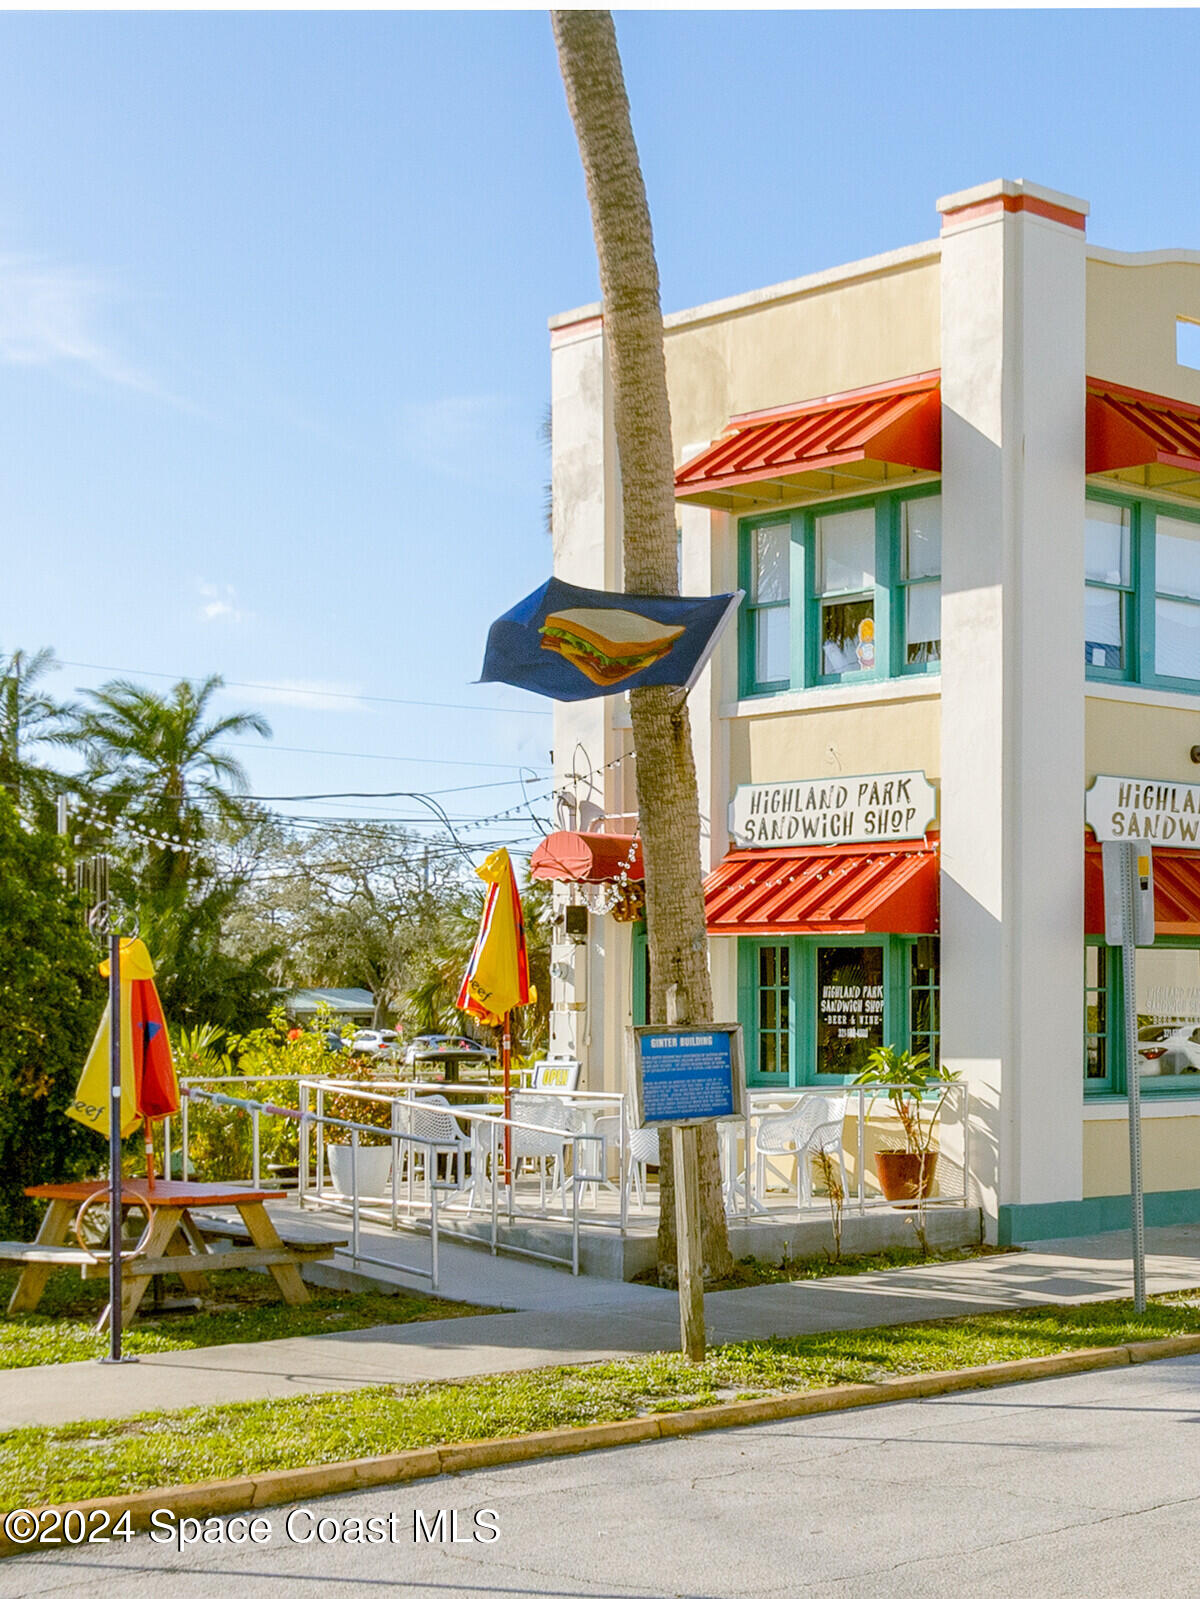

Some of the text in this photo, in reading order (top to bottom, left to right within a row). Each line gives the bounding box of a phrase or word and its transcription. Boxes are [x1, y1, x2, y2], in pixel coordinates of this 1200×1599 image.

[750, 778, 911, 815] HIGHLAND PARK
[744, 807, 916, 841] SANDWICH SHOP
[823, 985, 884, 999] HIGHLAND PARK
[821, 999, 885, 1013] SANDWICH SHOP
[651, 1036, 713, 1049] GINTER BUILDING
[543, 1069, 569, 1086] OPEN
